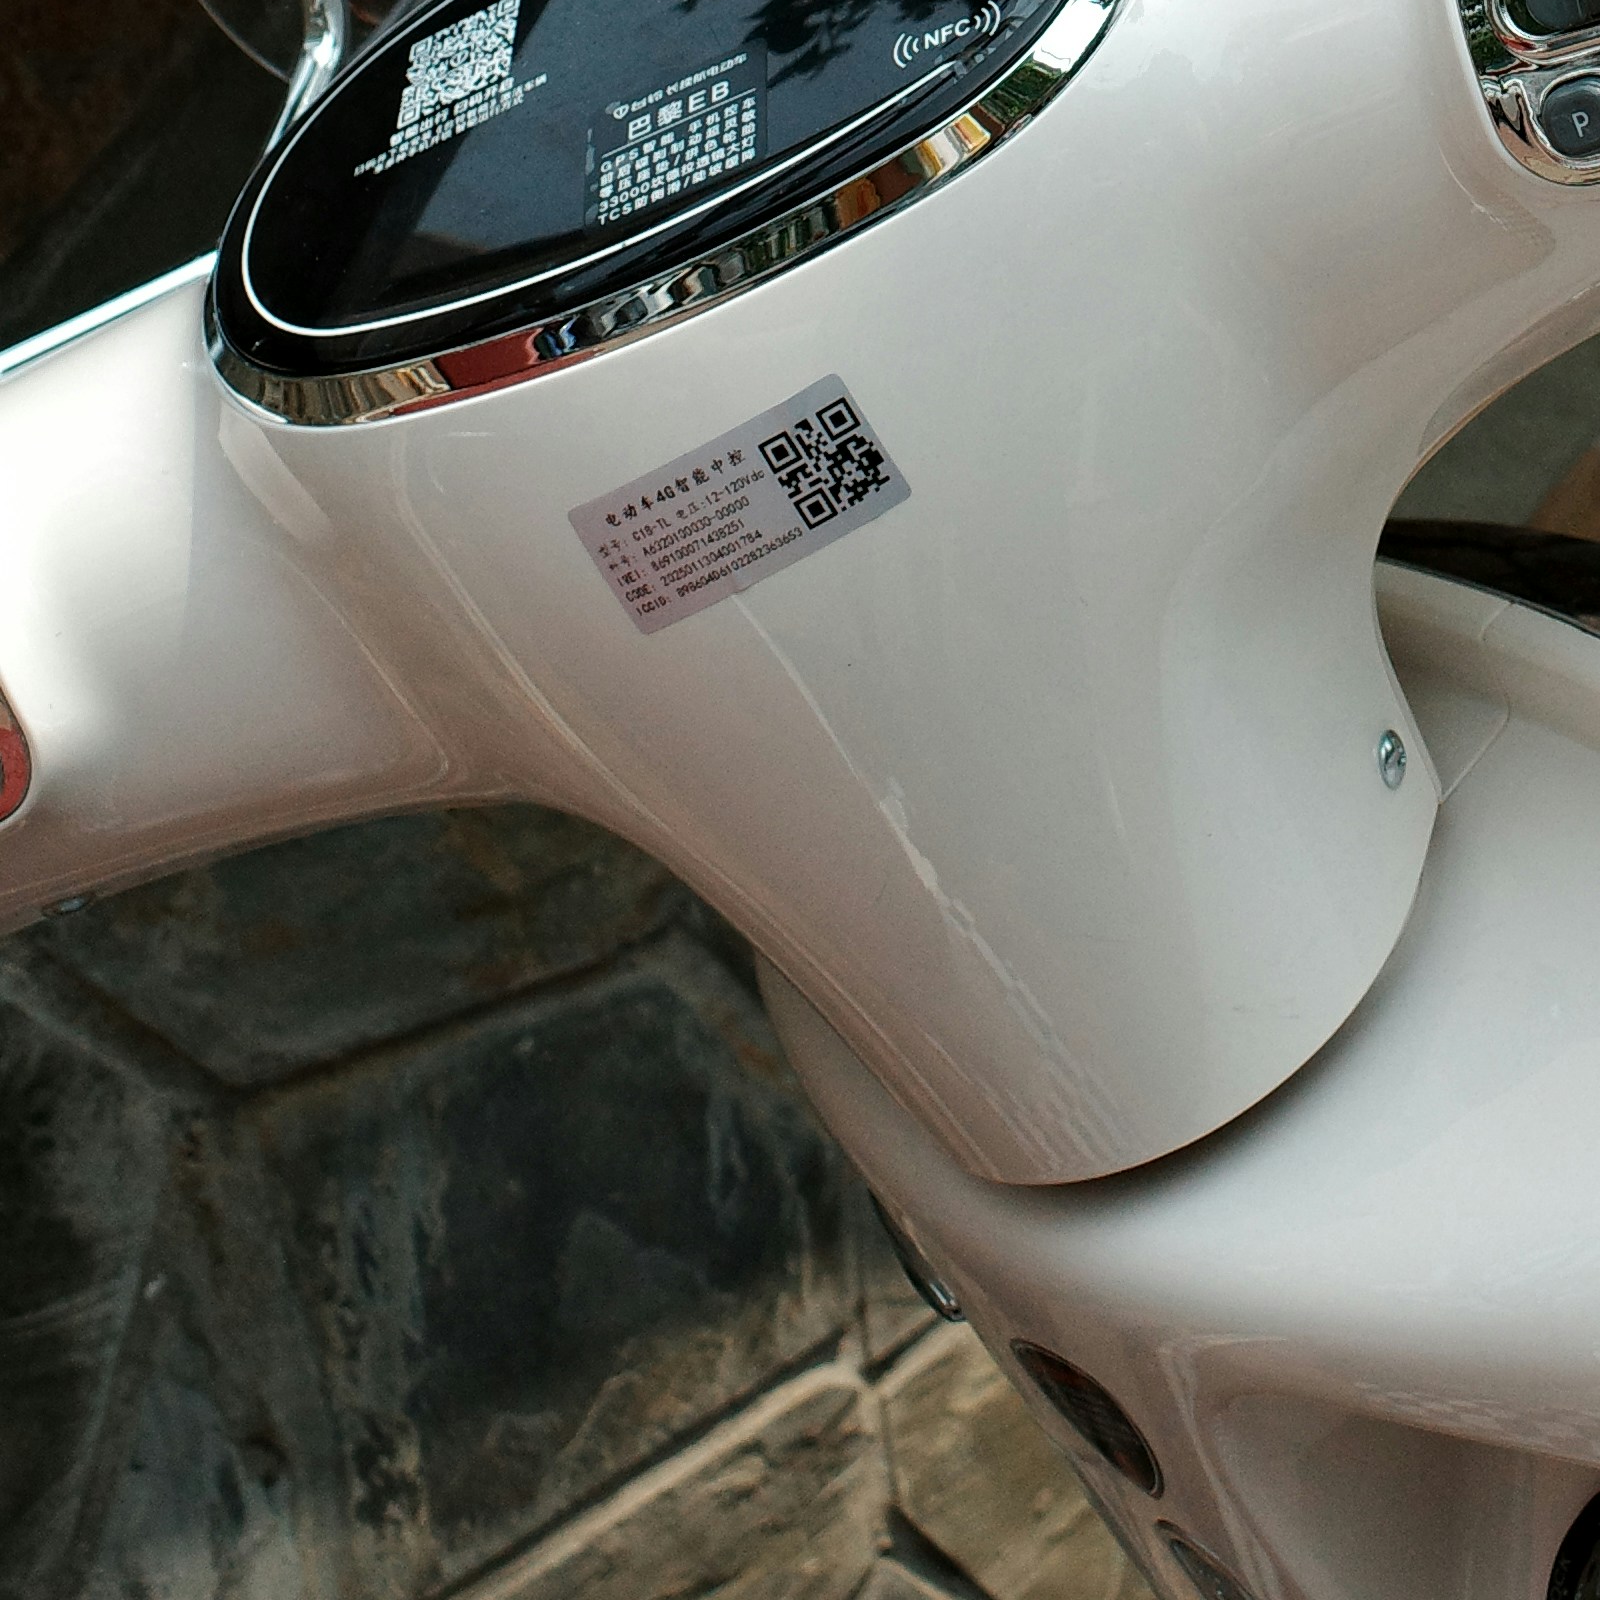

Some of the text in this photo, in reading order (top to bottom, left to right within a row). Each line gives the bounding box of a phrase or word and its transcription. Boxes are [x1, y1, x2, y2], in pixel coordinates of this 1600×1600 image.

[924, 18, 970, 50] NFC
[1571, 112, 1590, 138] P
[604, 448, 747, 528] 电动车4G智能中控
